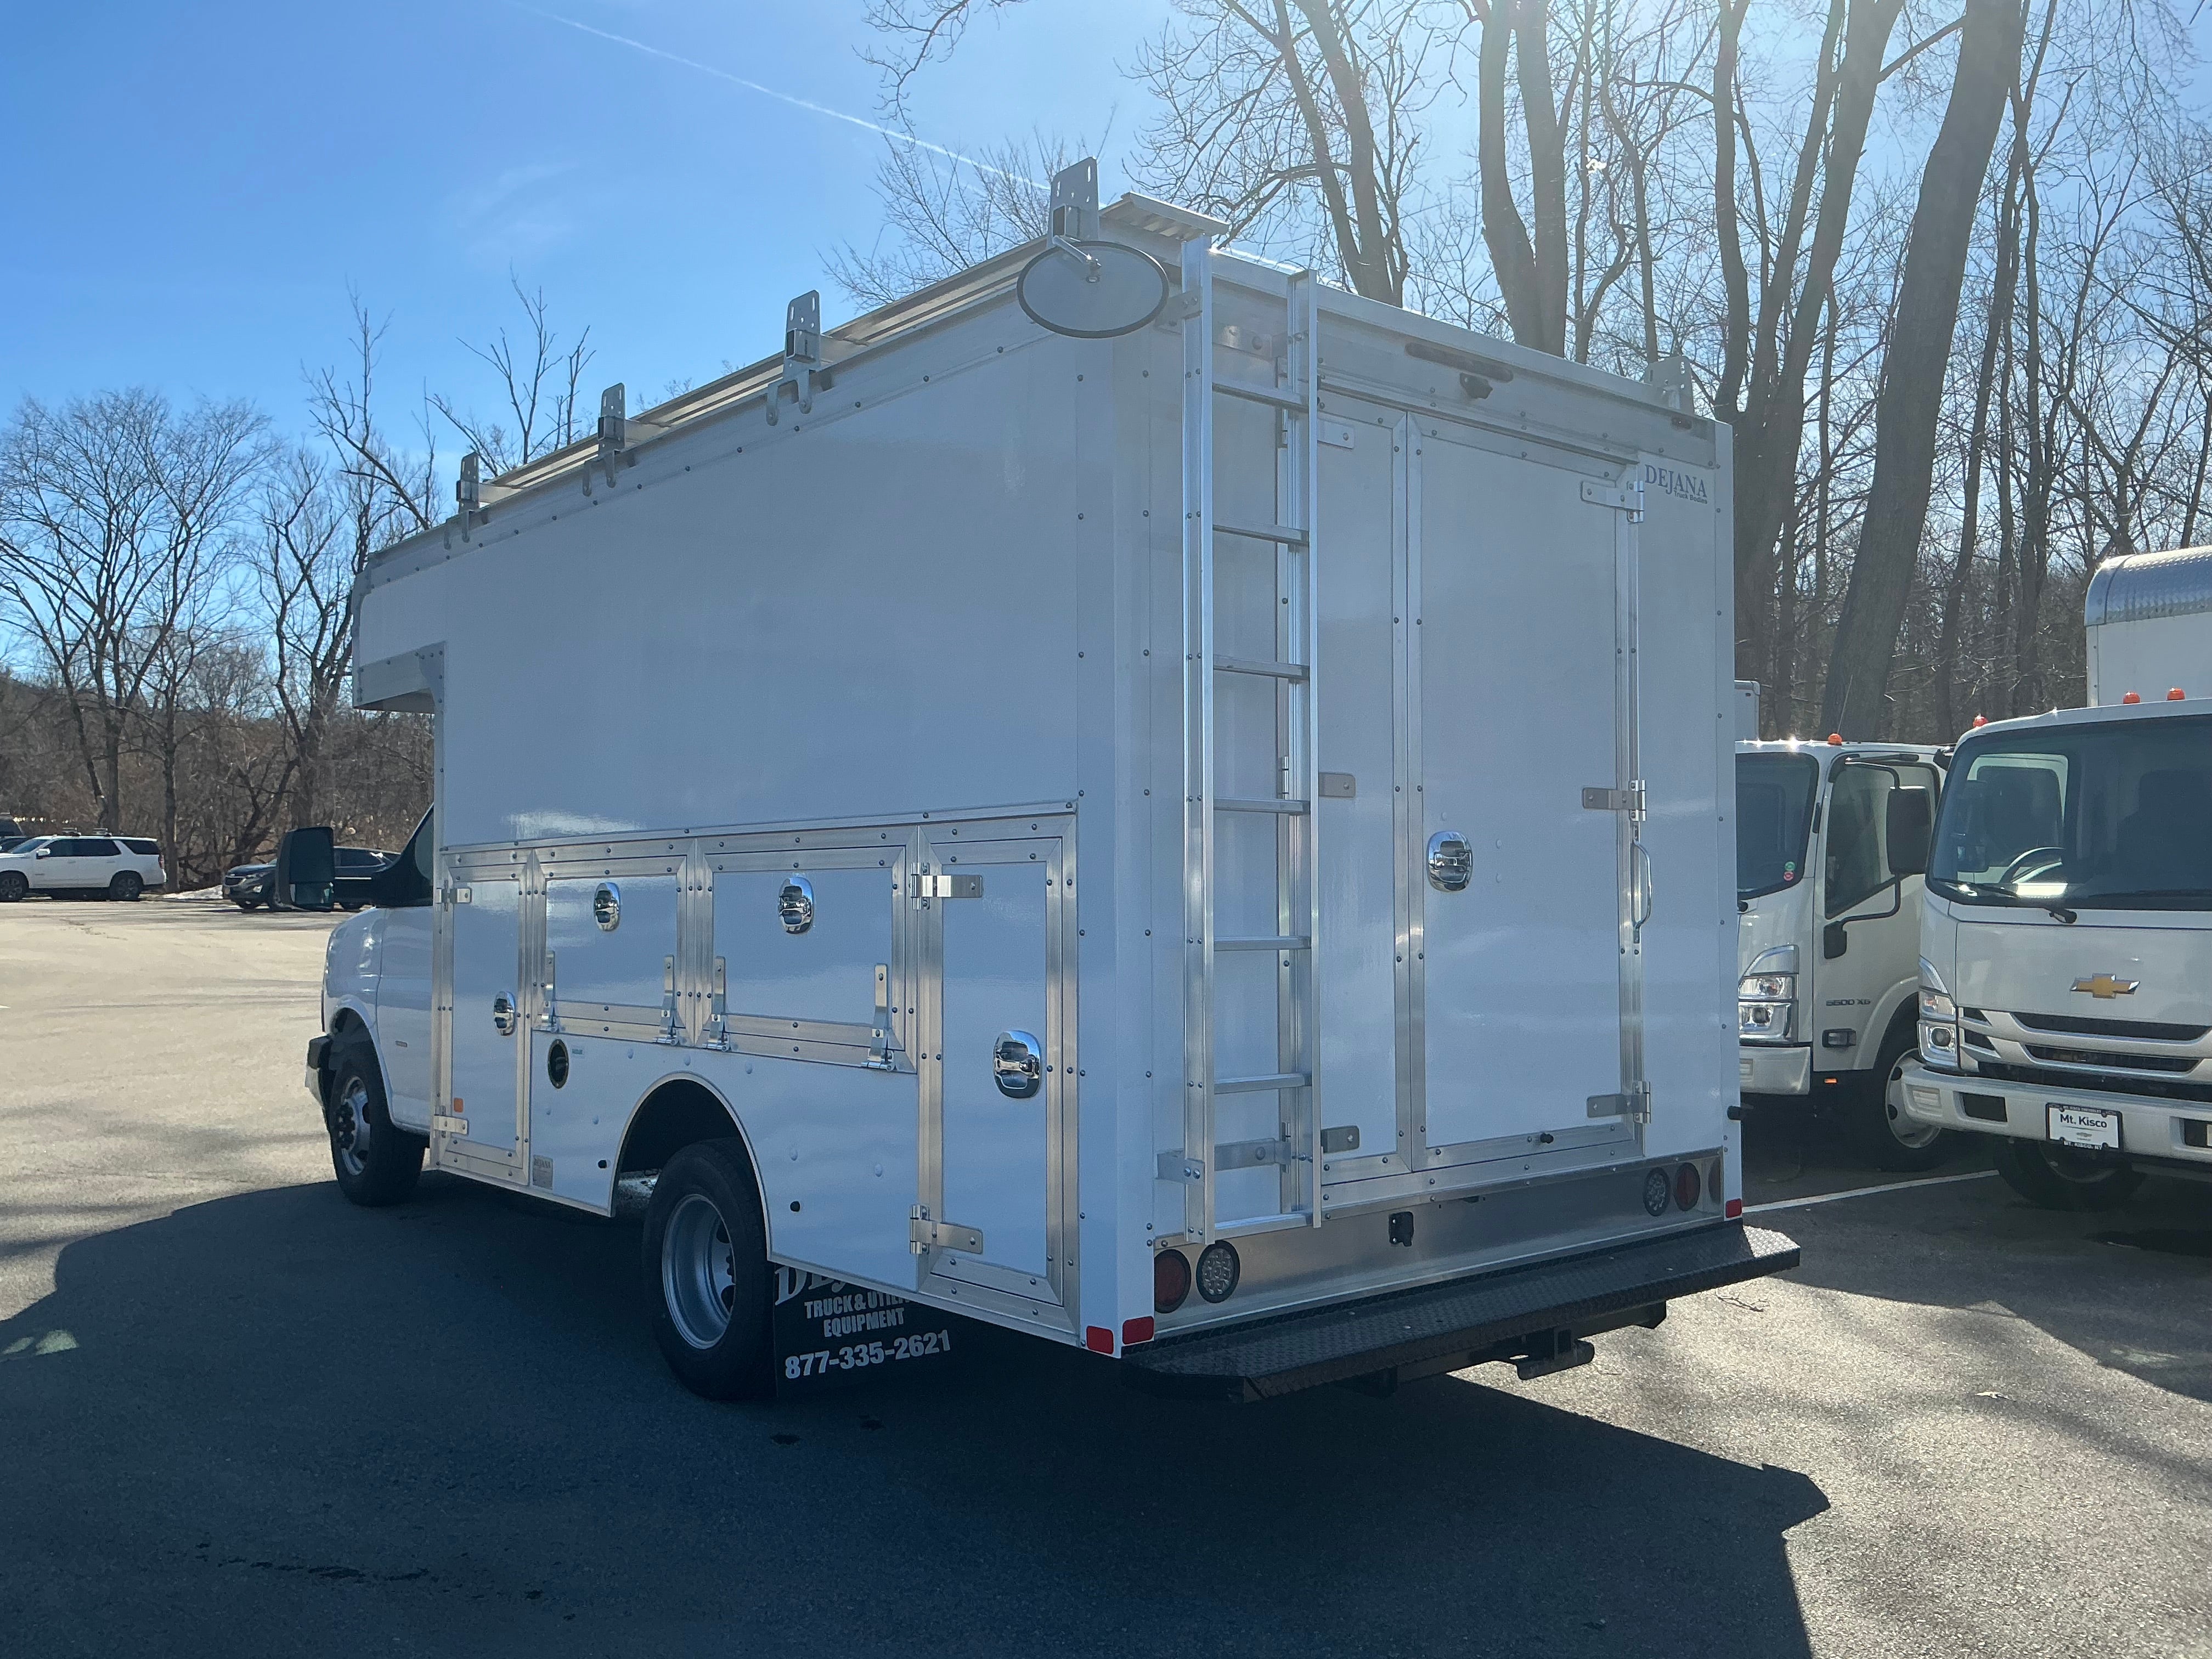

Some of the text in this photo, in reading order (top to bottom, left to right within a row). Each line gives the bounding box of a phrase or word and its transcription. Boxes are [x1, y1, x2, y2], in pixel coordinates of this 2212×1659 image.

[1645, 464, 1708, 498] DEJANA
[2060, 1114, 2107, 1128] Mt. Kisco
[804, 1294, 854, 1319] TRUCK
[823, 1307, 905, 1338] EQUIPMENT
[785, 1329, 951, 1379] 877-335-2621
